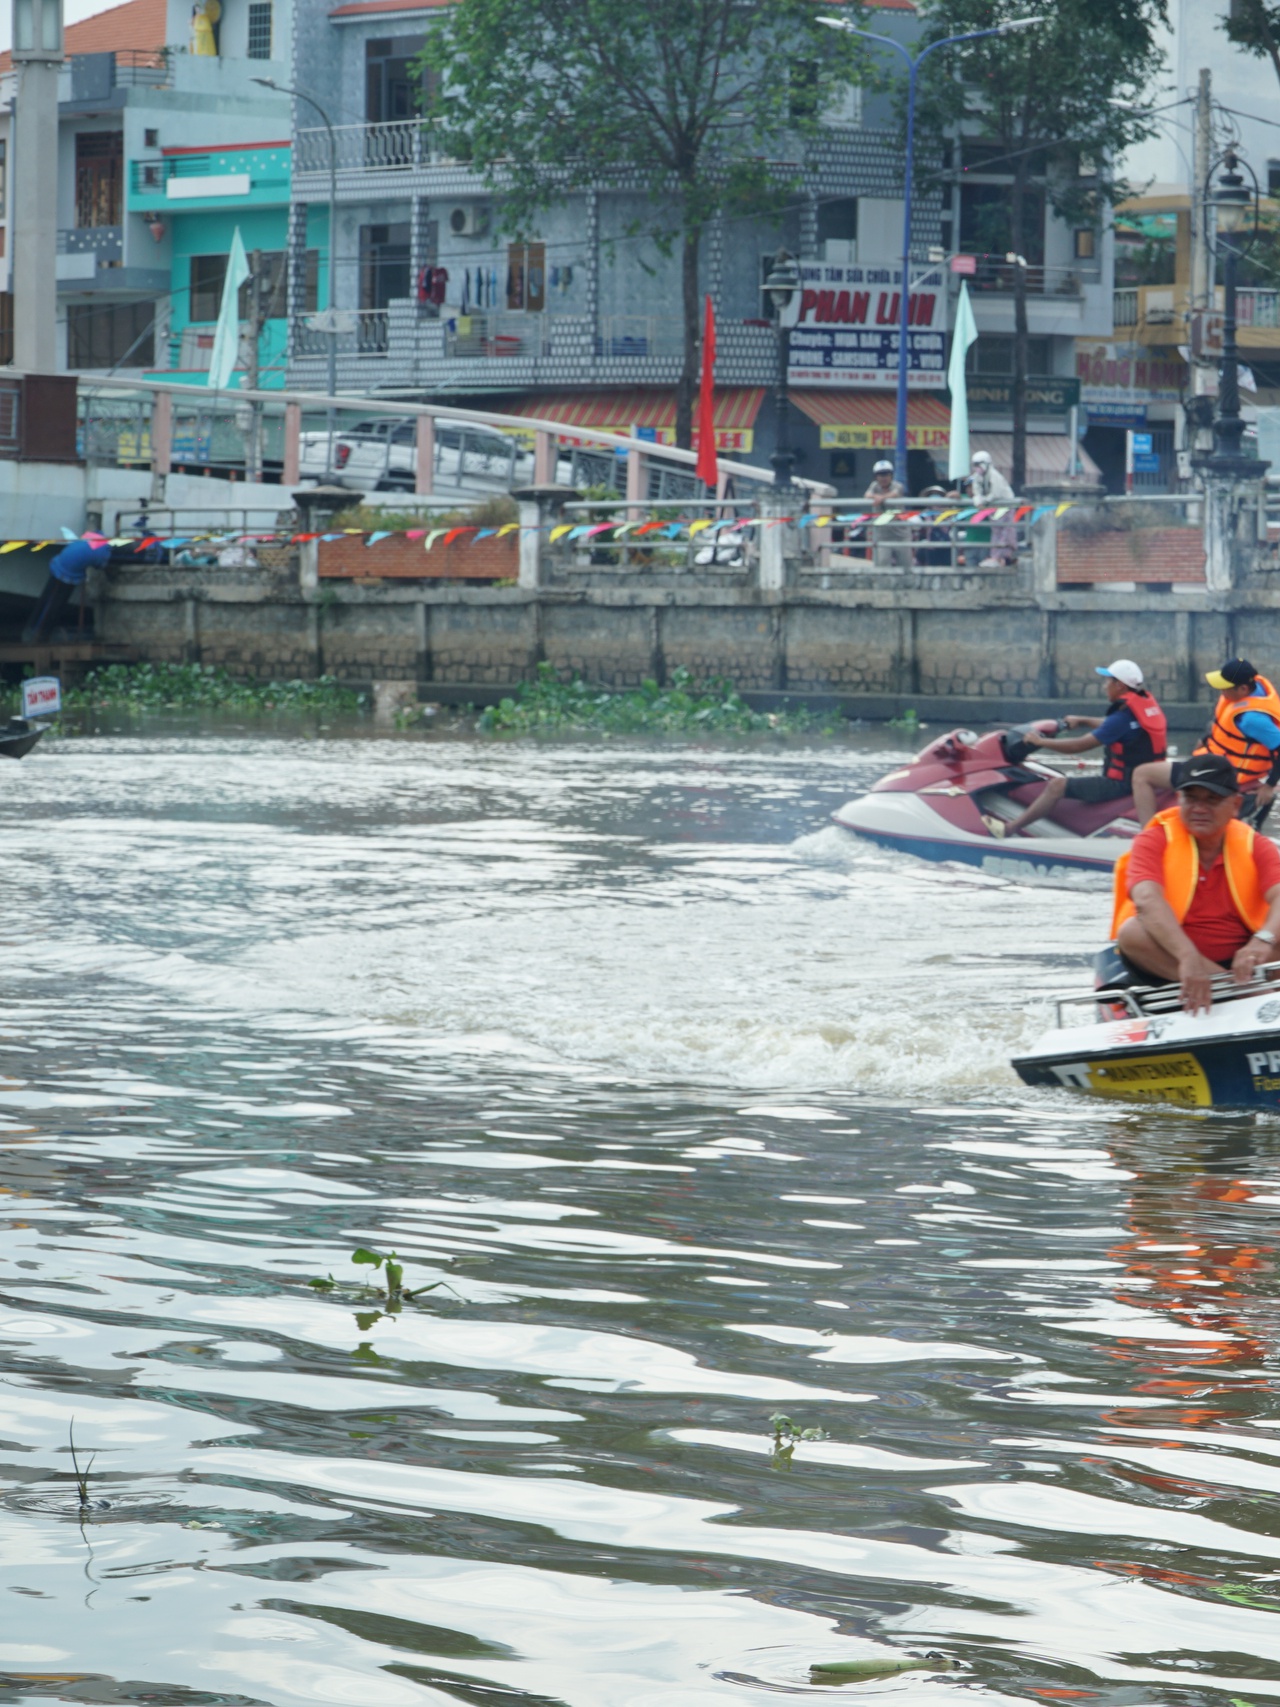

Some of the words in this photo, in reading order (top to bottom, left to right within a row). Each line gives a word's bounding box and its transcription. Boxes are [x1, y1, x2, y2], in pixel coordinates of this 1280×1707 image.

[799, 289, 870, 324] PHAN
[831, 352, 878, 367] SAMSUNG
[1024, 390, 1064, 405] ONG
